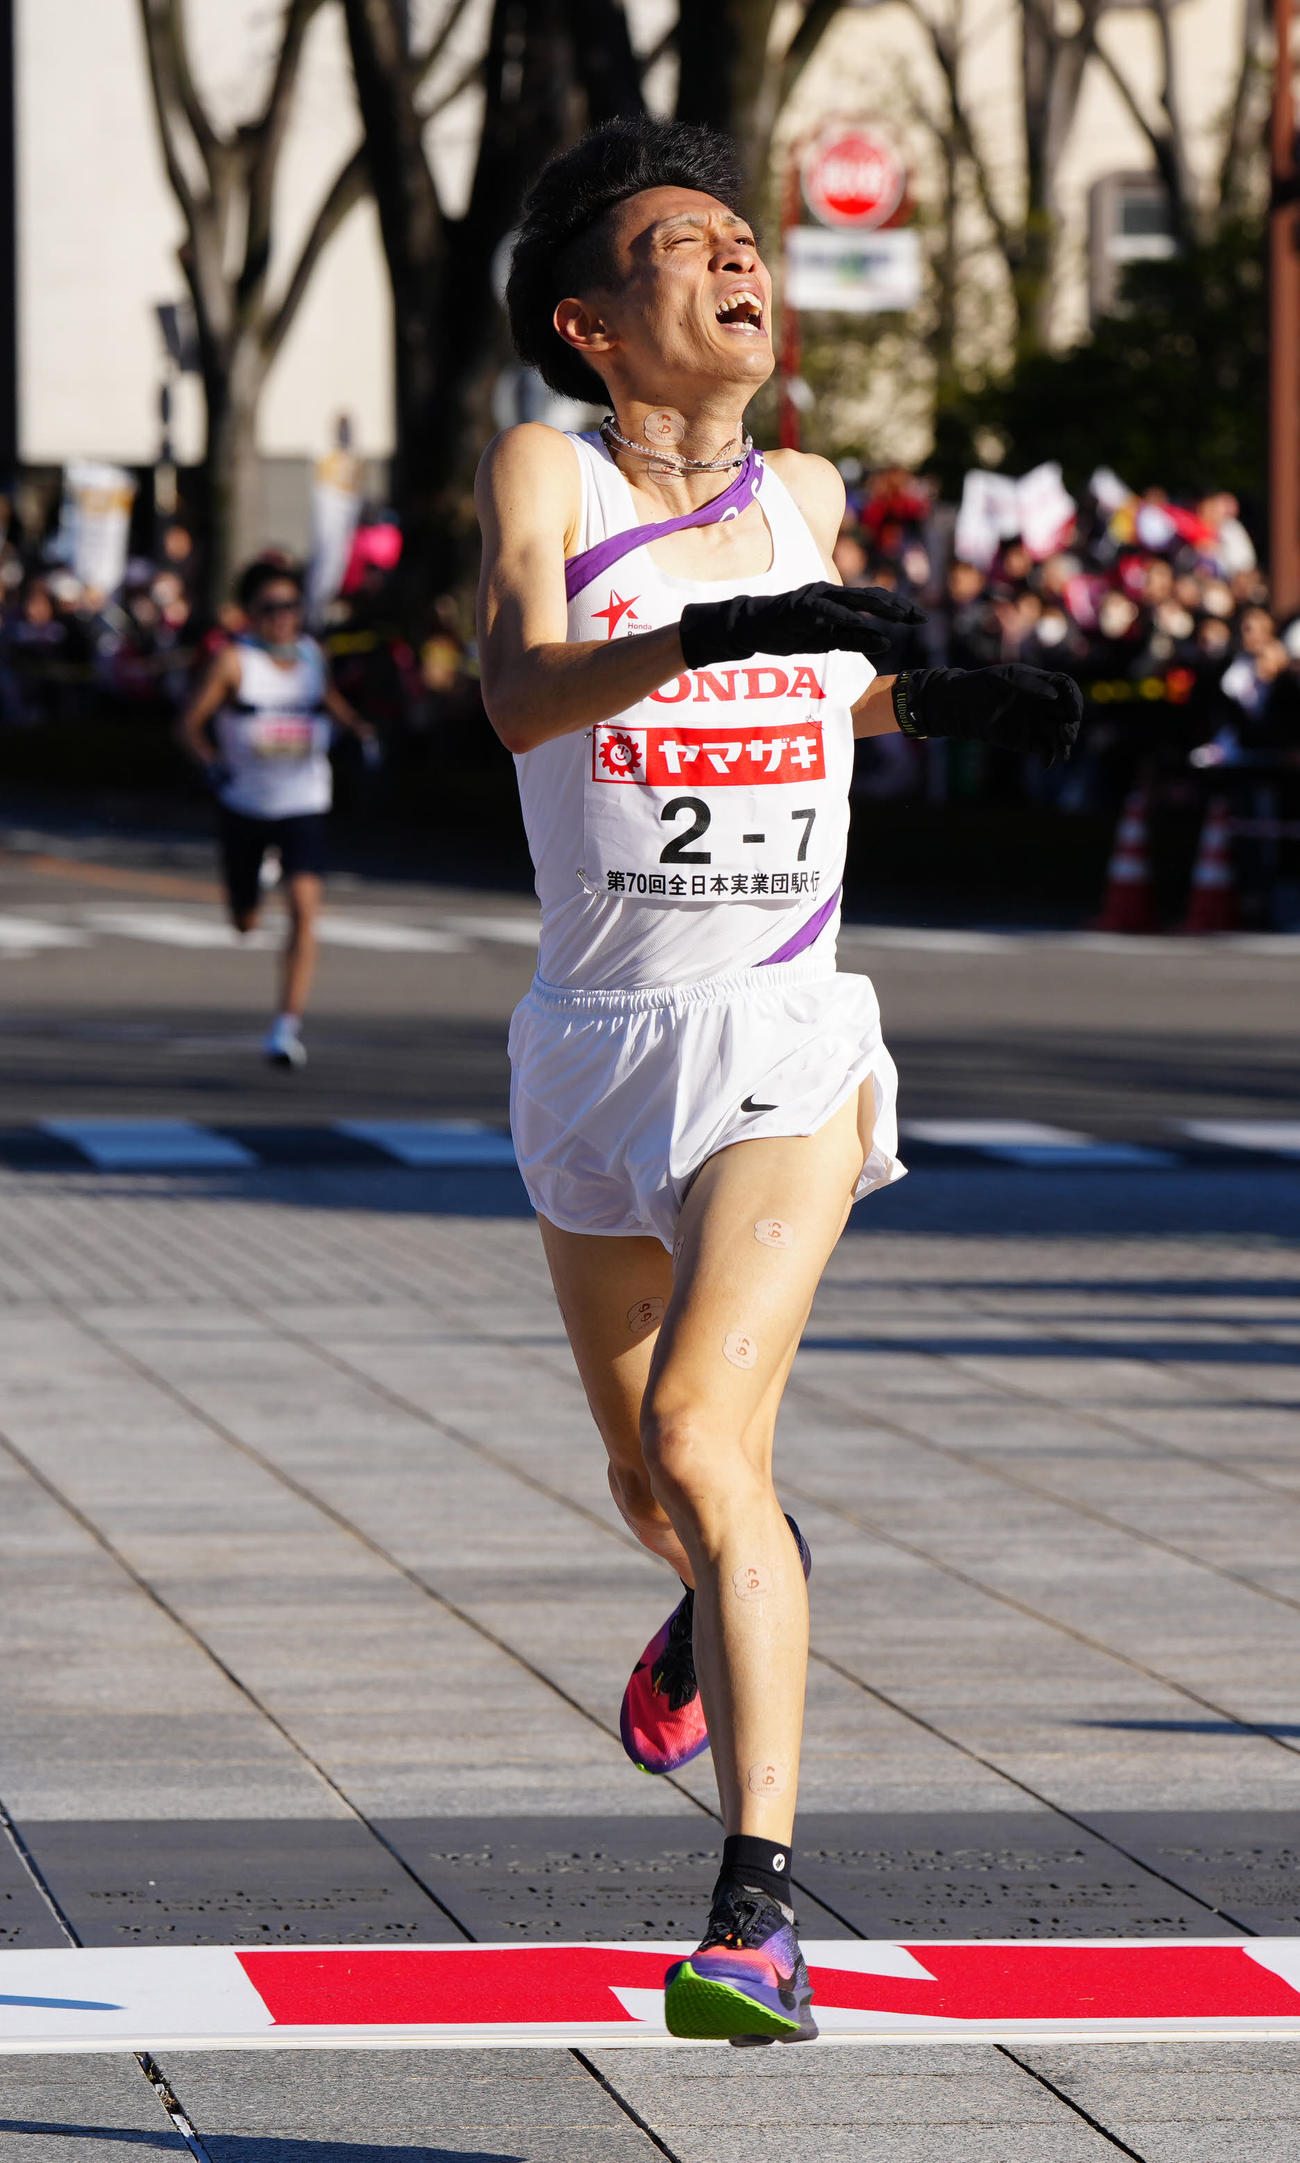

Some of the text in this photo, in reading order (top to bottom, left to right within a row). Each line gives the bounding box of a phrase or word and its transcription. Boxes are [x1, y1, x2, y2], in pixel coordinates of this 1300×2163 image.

[627, 622, 652, 630] Honda
[642, 666, 826, 704] ONDA
[658, 736, 817, 774] ヤマザキ
